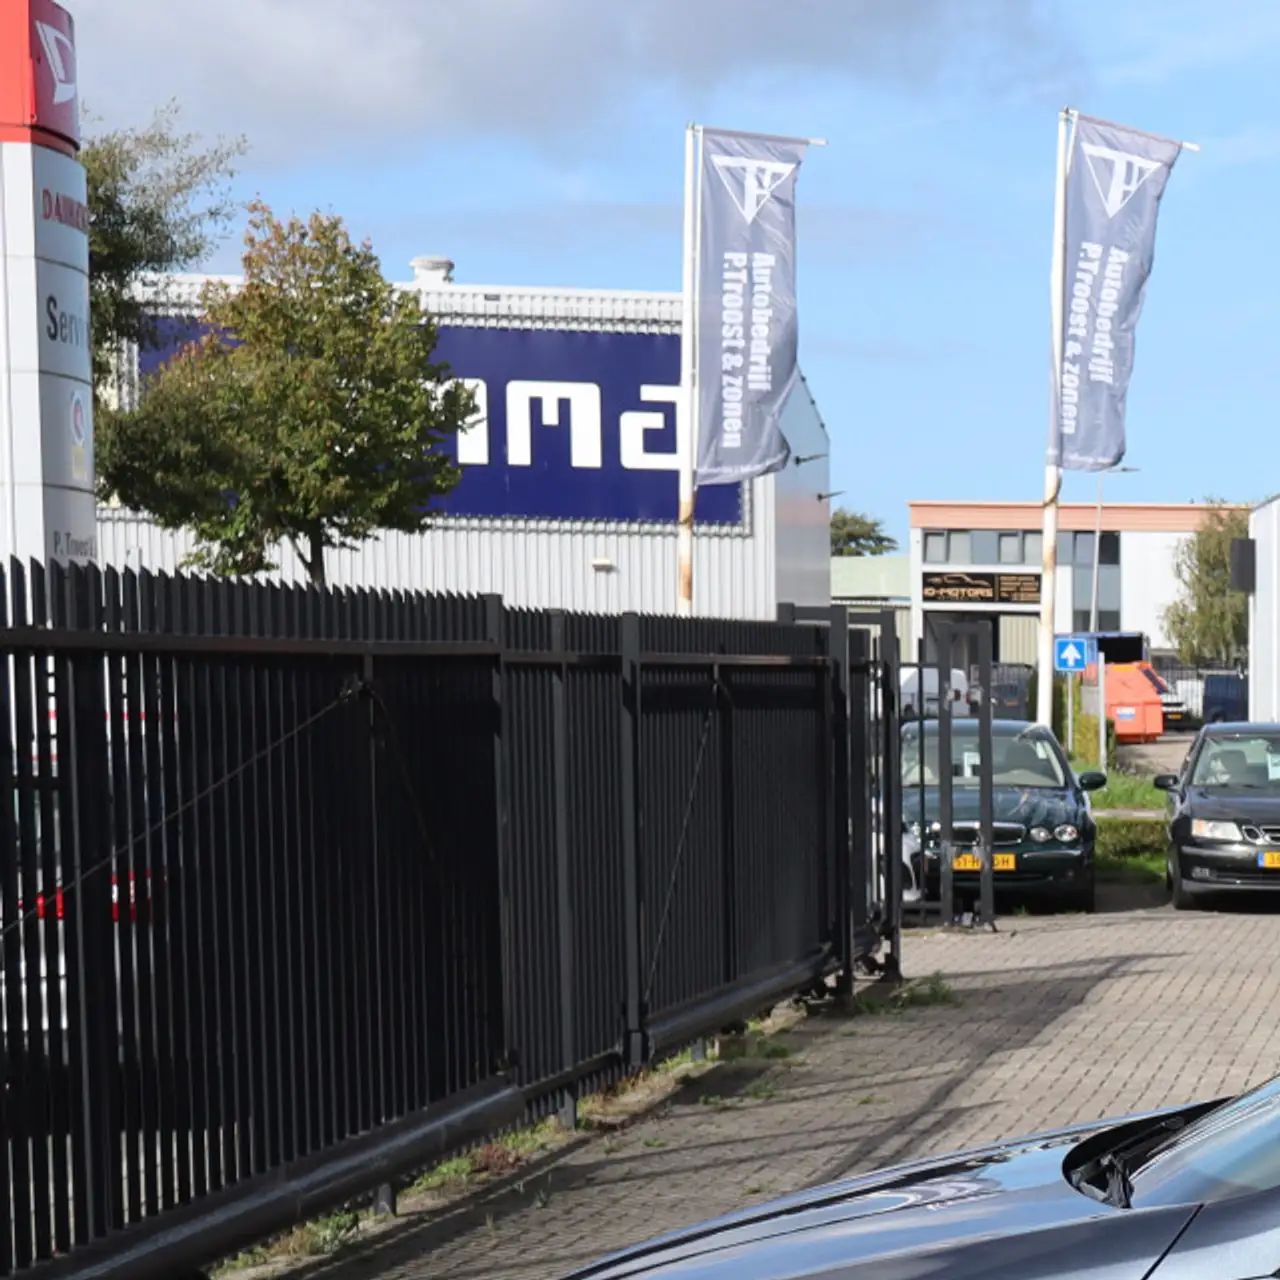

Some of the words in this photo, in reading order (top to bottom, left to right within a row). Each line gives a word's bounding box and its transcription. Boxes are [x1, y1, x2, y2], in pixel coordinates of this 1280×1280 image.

[747, 252, 776, 392] Autobedrijf
[1089, 246, 1129, 386] Autobedrijf
[721, 374, 742, 449] zonen
[1060, 361, 1081, 435] zonen
